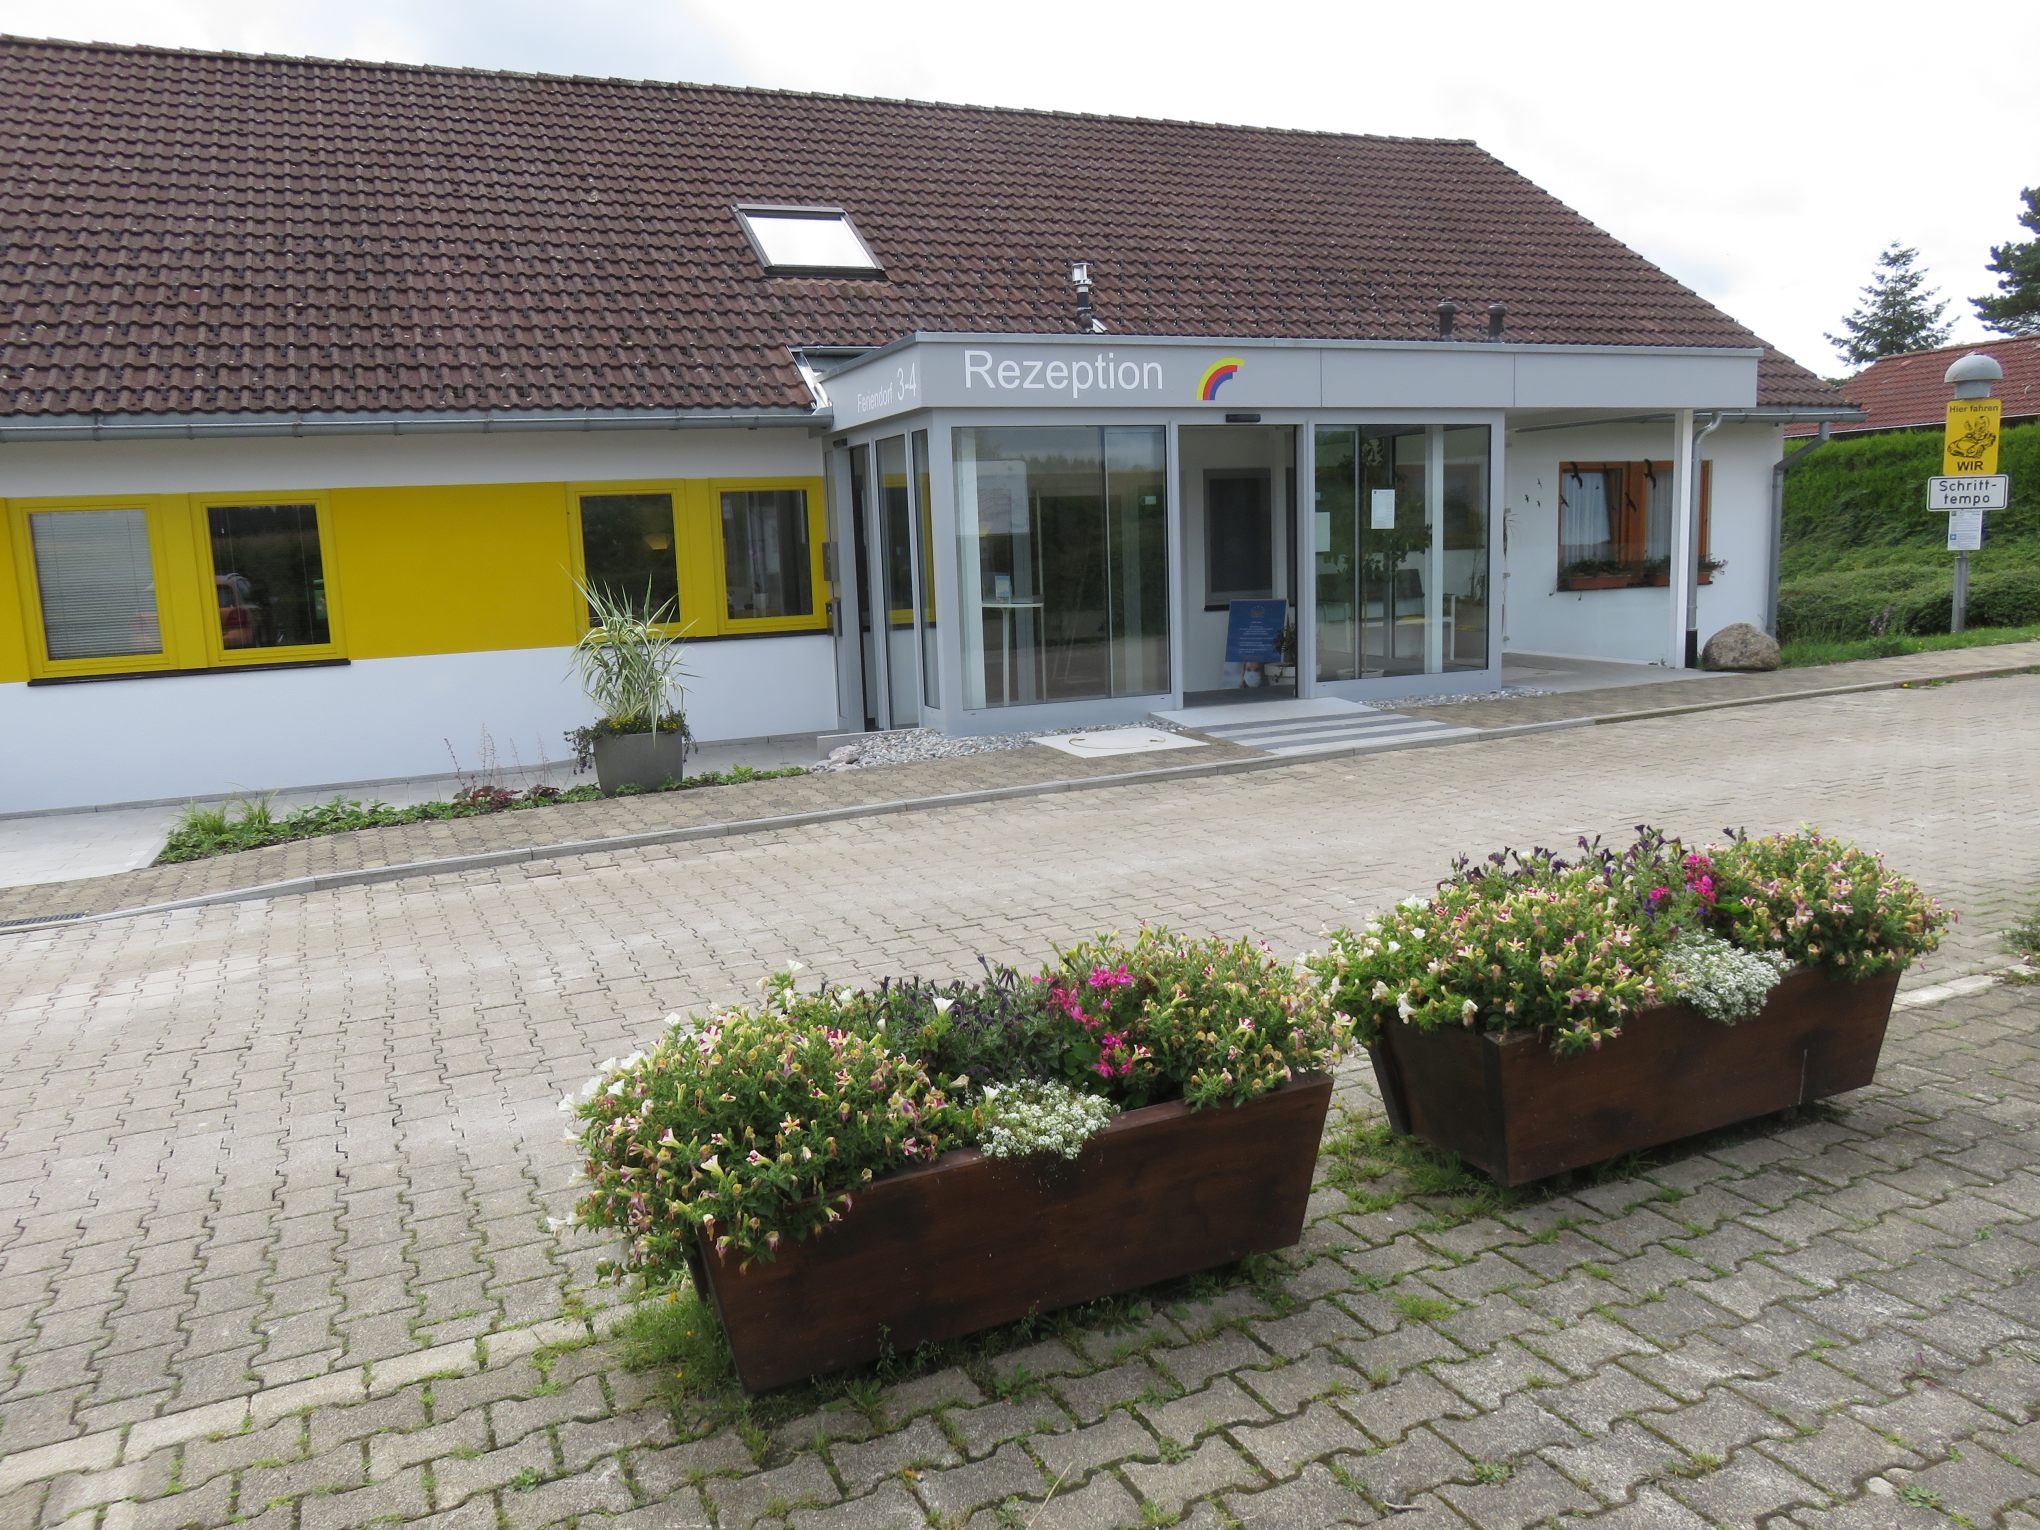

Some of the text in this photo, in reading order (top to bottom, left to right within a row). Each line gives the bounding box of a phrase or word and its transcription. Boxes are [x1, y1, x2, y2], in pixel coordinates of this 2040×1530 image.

[964, 349, 1163, 398] Rezeption
[857, 362, 917, 413] Feriendorf 3-4
[1949, 404, 1999, 413] Hier fahren
[1957, 460, 1984, 471] WIR
[1939, 480, 1997, 492] Schritt-
[1944, 494, 1990, 506] tempo
